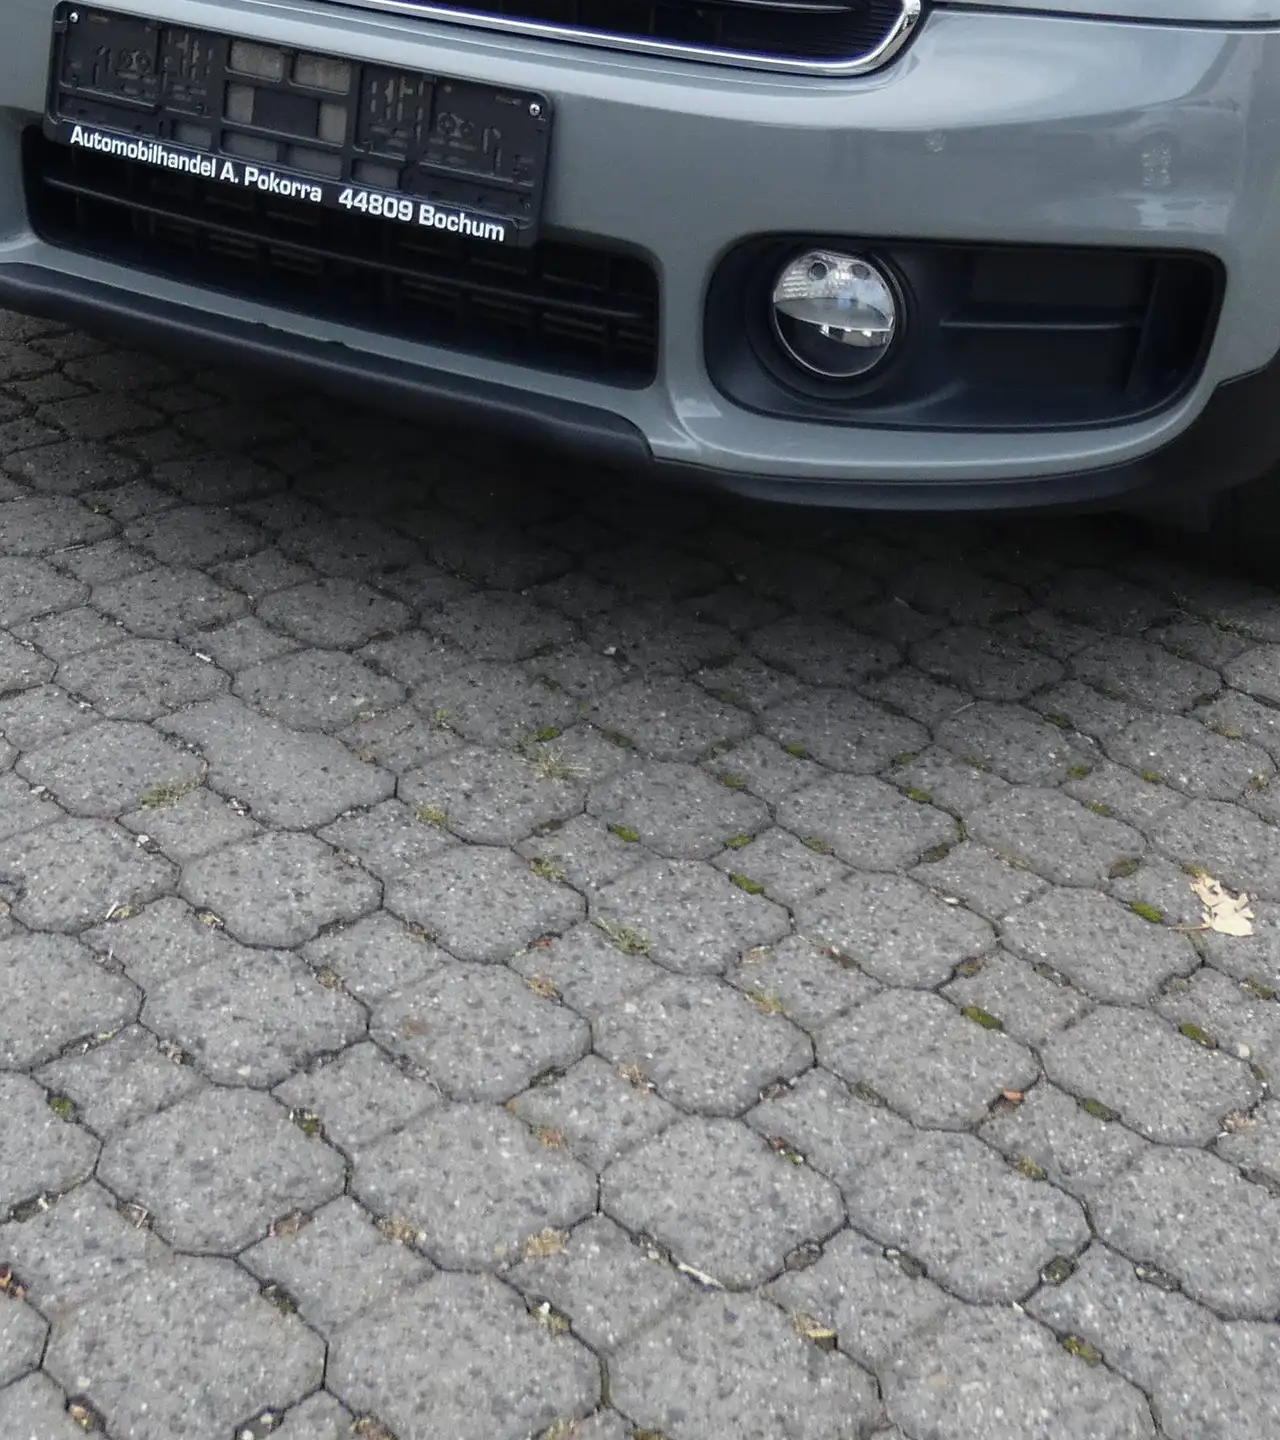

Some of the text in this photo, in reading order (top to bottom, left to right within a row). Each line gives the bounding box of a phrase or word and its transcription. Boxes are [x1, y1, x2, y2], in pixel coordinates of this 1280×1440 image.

[70, 125, 505, 242] Automobilhandel A. Pokorra 44809 Bochum
